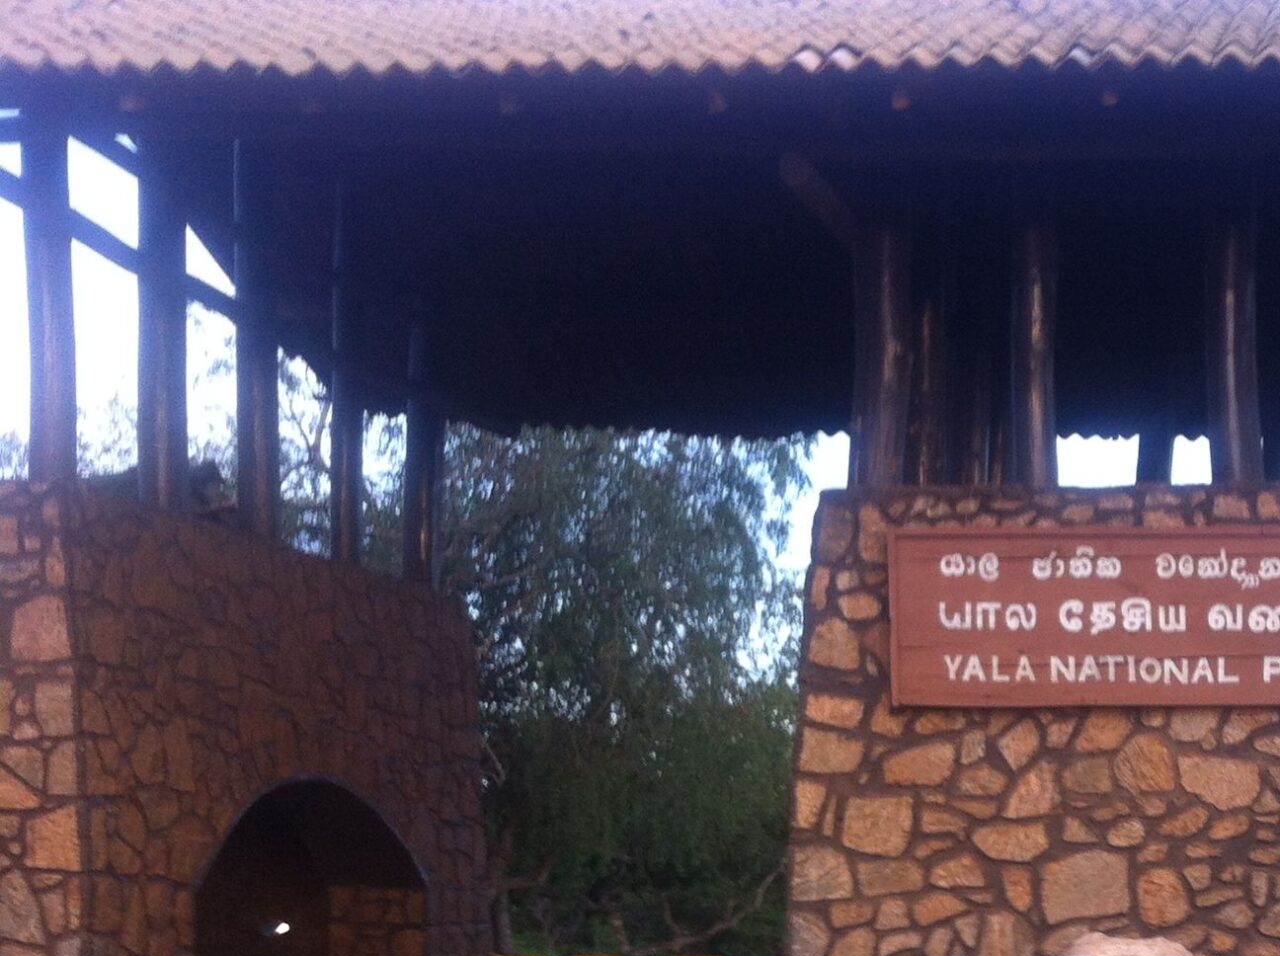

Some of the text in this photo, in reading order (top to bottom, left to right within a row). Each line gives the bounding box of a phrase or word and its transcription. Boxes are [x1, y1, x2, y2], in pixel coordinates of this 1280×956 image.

[939, 552, 1000, 582] යාල
[1031, 545, 1122, 580] ජාතික
[938, 600, 1038, 631] யால
[1057, 596, 1187, 635] தேசிய
[943, 654, 1037, 682] YALA
[1049, 654, 1240, 685] NATIONAL
